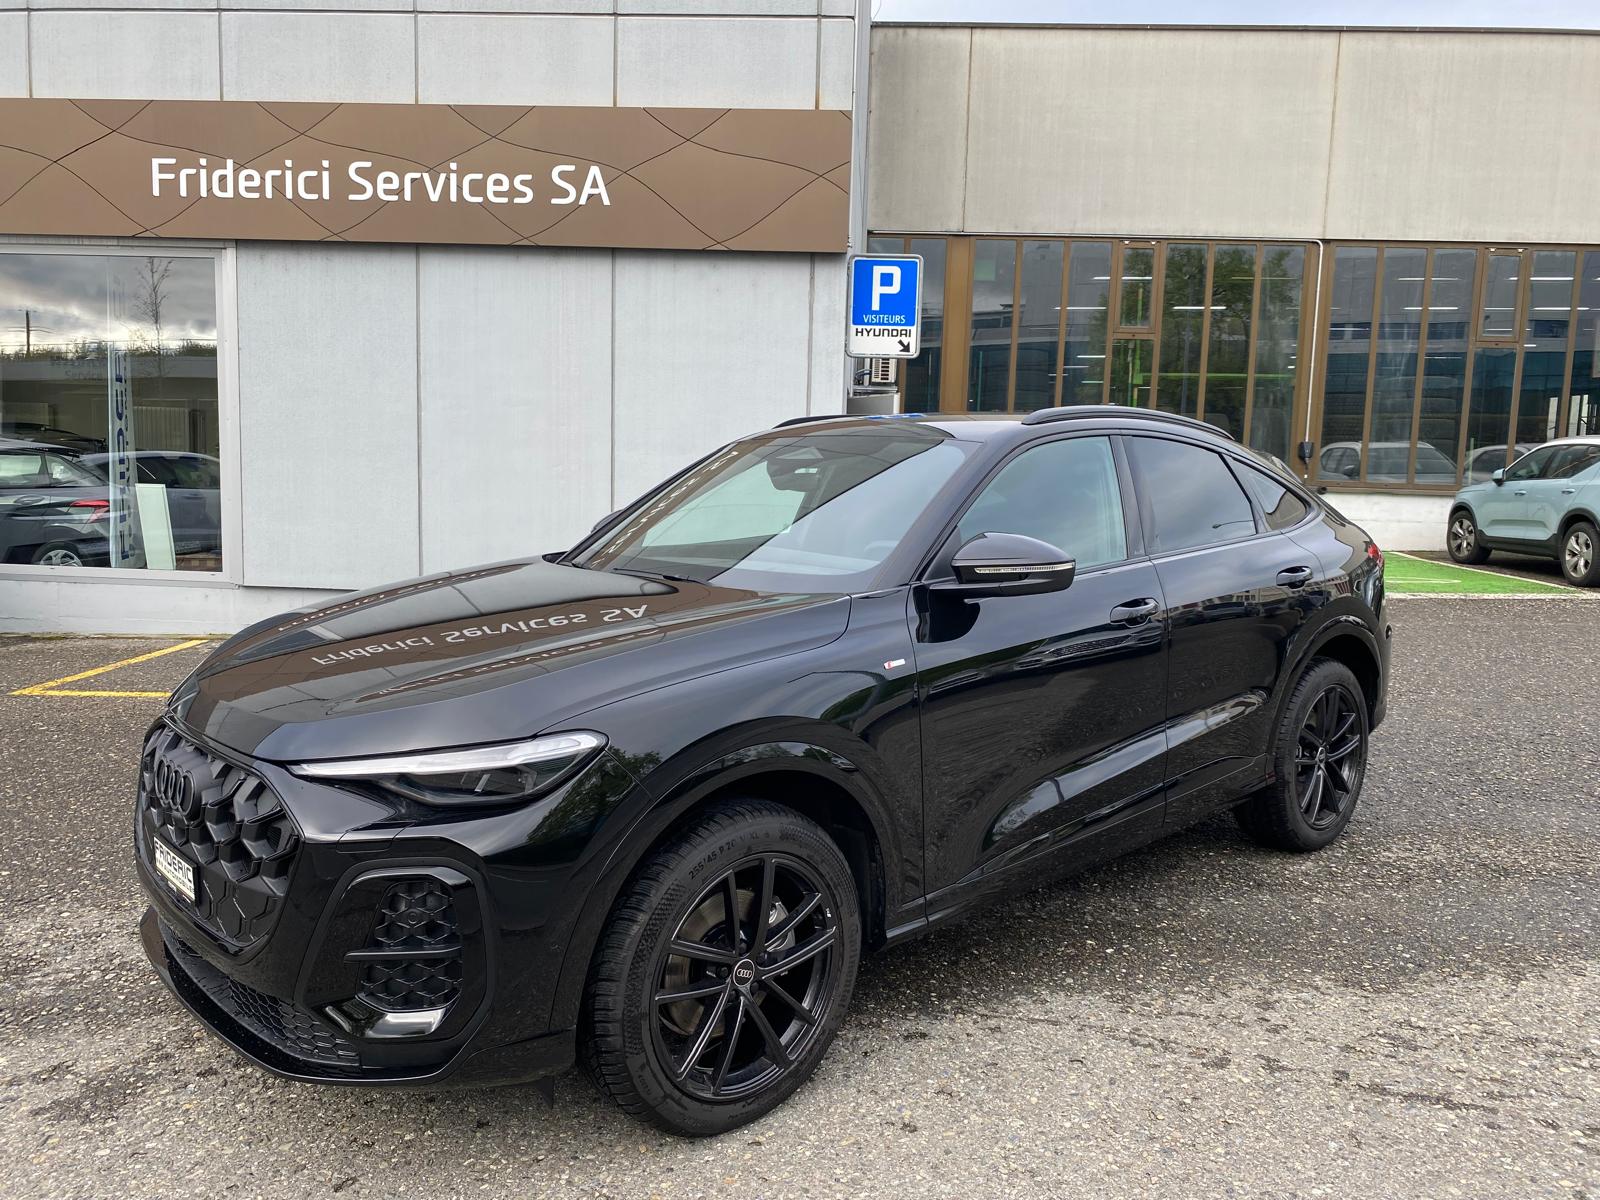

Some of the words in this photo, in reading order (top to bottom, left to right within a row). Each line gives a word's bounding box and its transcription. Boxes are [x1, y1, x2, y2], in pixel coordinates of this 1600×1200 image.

[152, 158, 330, 200] Friderici
[348, 161, 534, 204] Services
[550, 165, 611, 206] SA
[872, 265, 902, 311] P
[855, 327, 912, 338] HYUNDAI
[863, 314, 906, 324] VISITEURS
